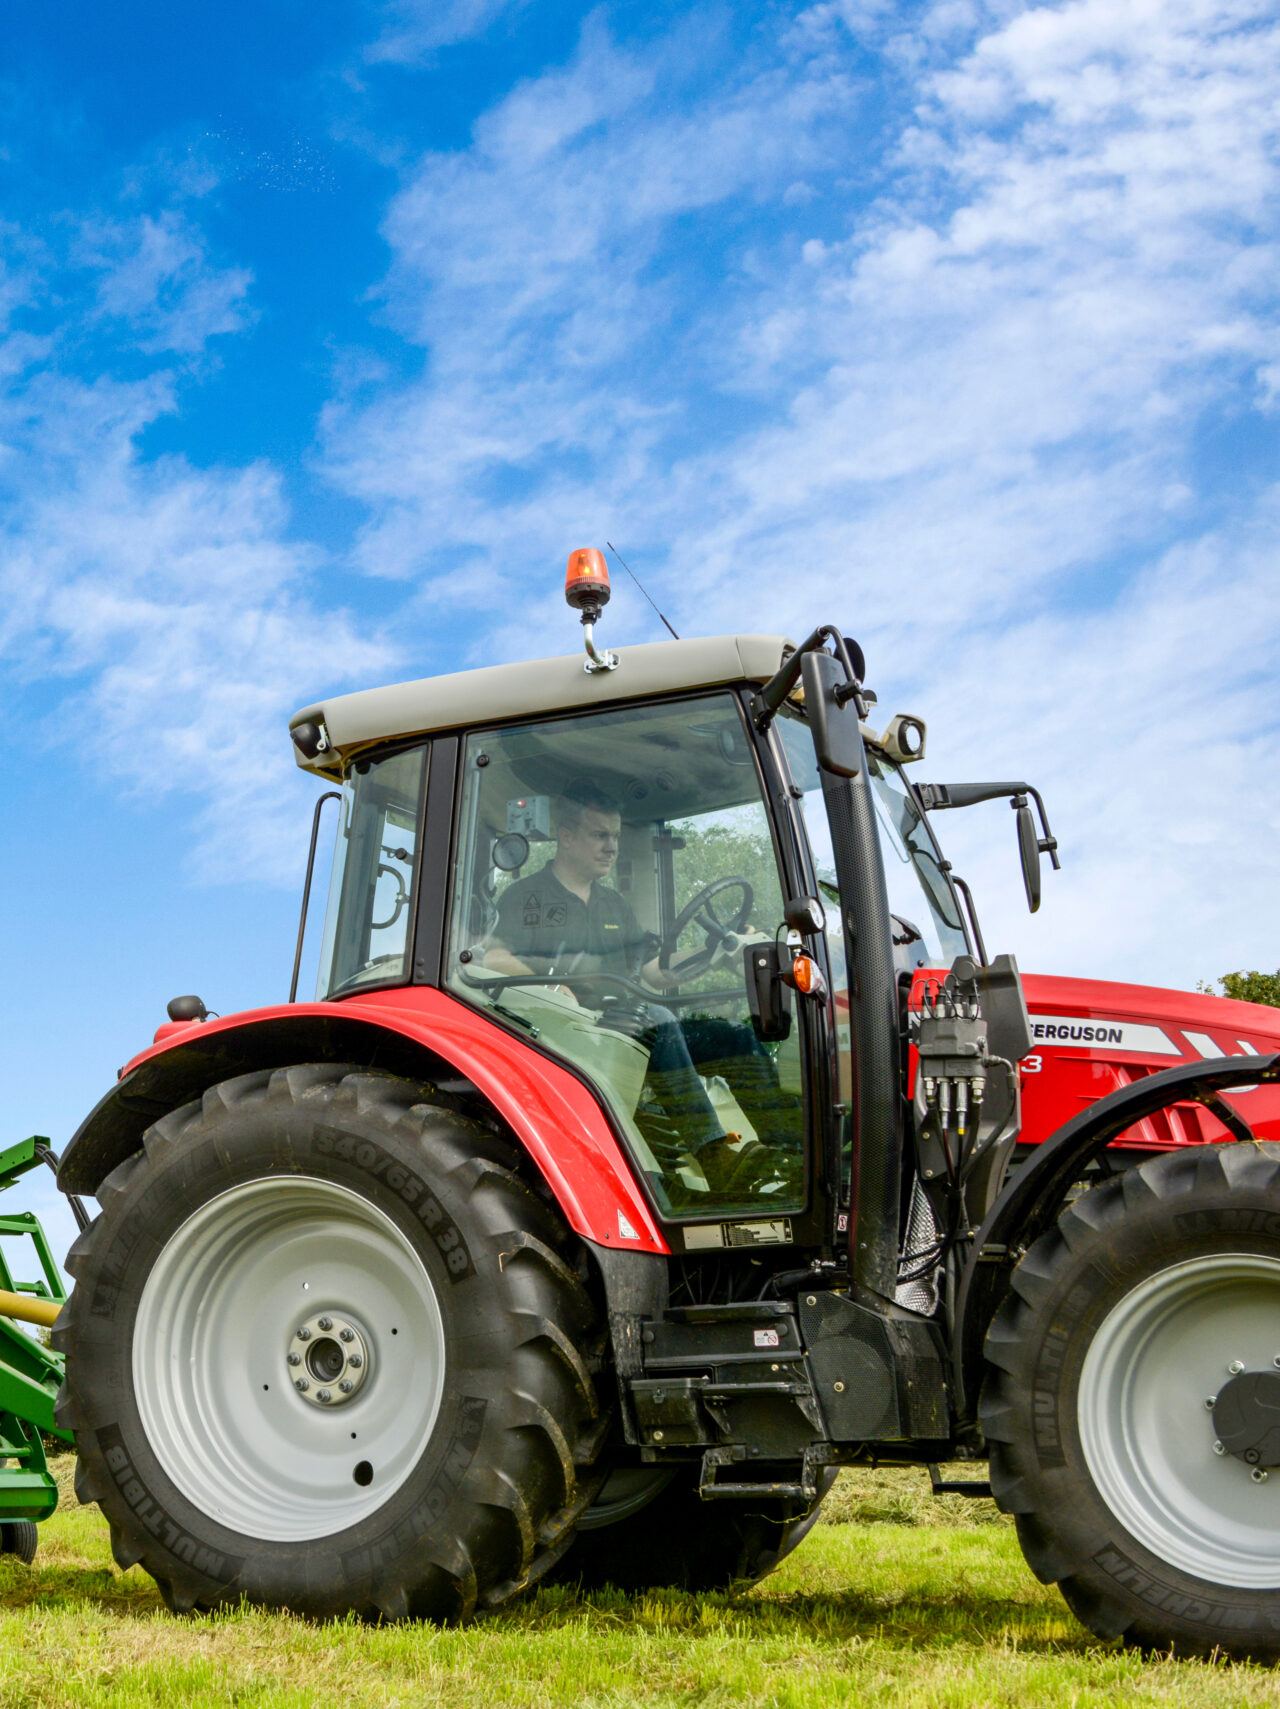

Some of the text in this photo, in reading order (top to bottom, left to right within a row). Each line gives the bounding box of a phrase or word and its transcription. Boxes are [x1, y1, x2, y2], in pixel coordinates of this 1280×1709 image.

[316, 1133, 468, 1275] 540/65 R 38
[104, 1445, 225, 1578] MULTIBIB
[1099, 1550, 1258, 1630] MICHELIN
